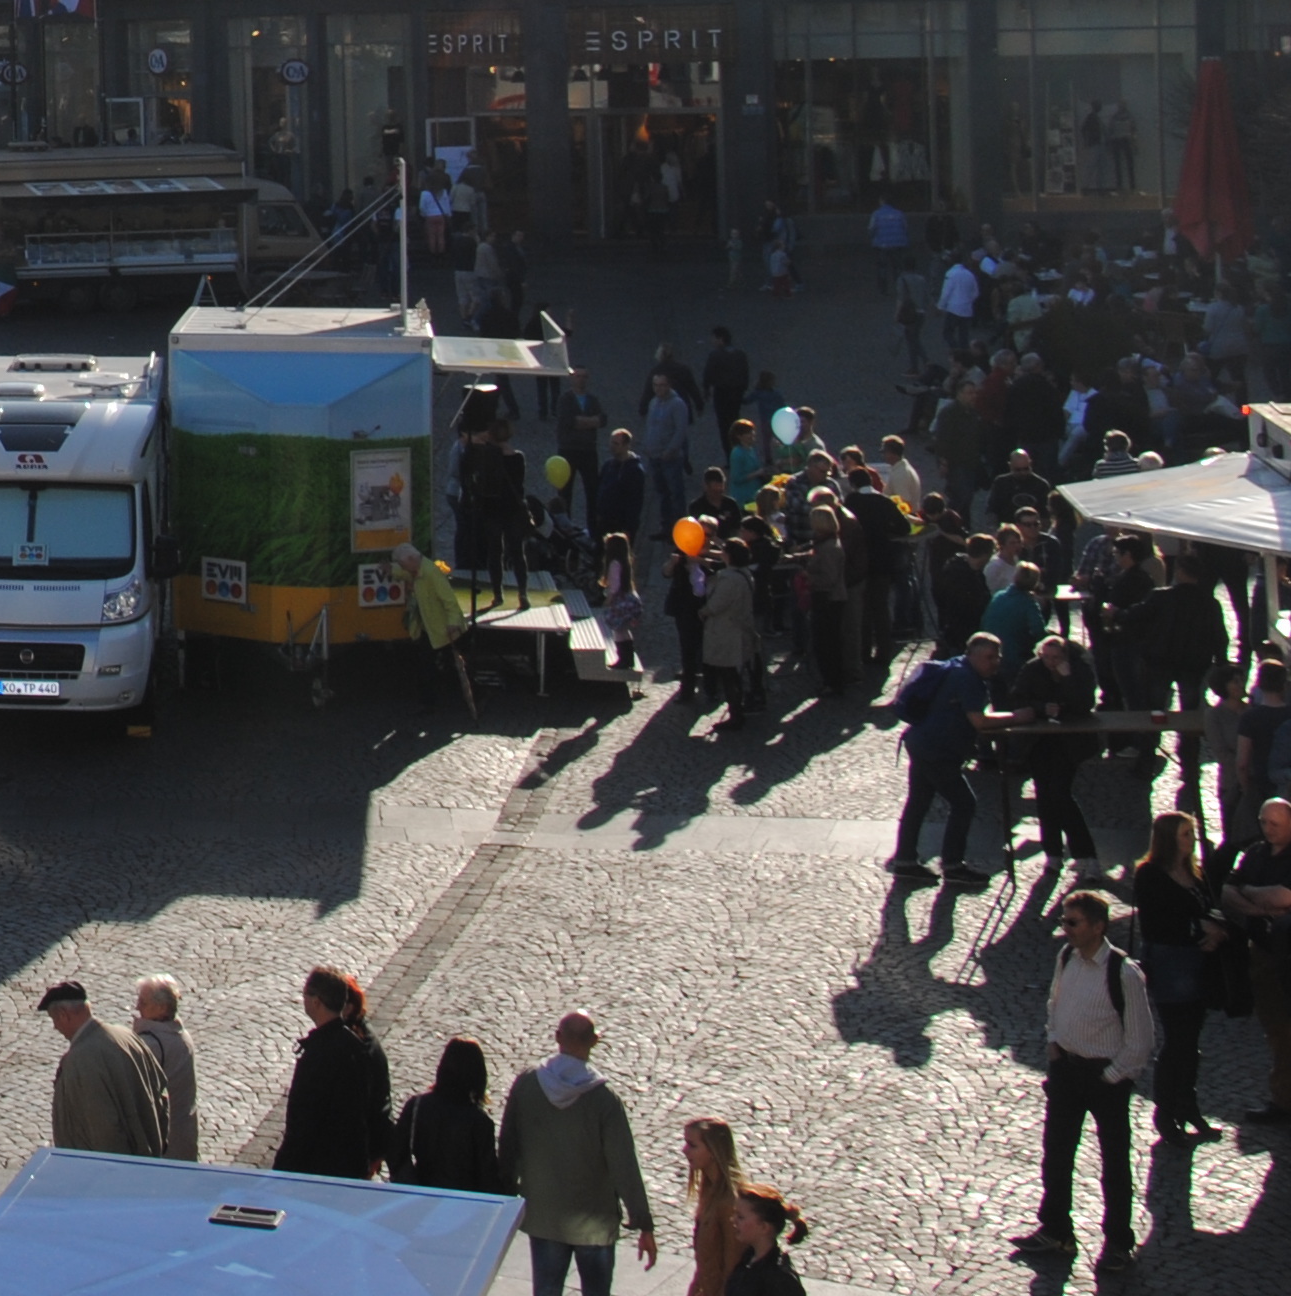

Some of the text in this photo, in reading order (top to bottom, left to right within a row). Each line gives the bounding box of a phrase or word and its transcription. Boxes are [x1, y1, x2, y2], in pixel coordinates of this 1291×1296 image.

[428, 34, 508, 53] ESPRIT
[586, 29, 722, 51] ESPRIT
[363, 569, 393, 585] EV
[2, 683, 57, 693] KO TP 440
